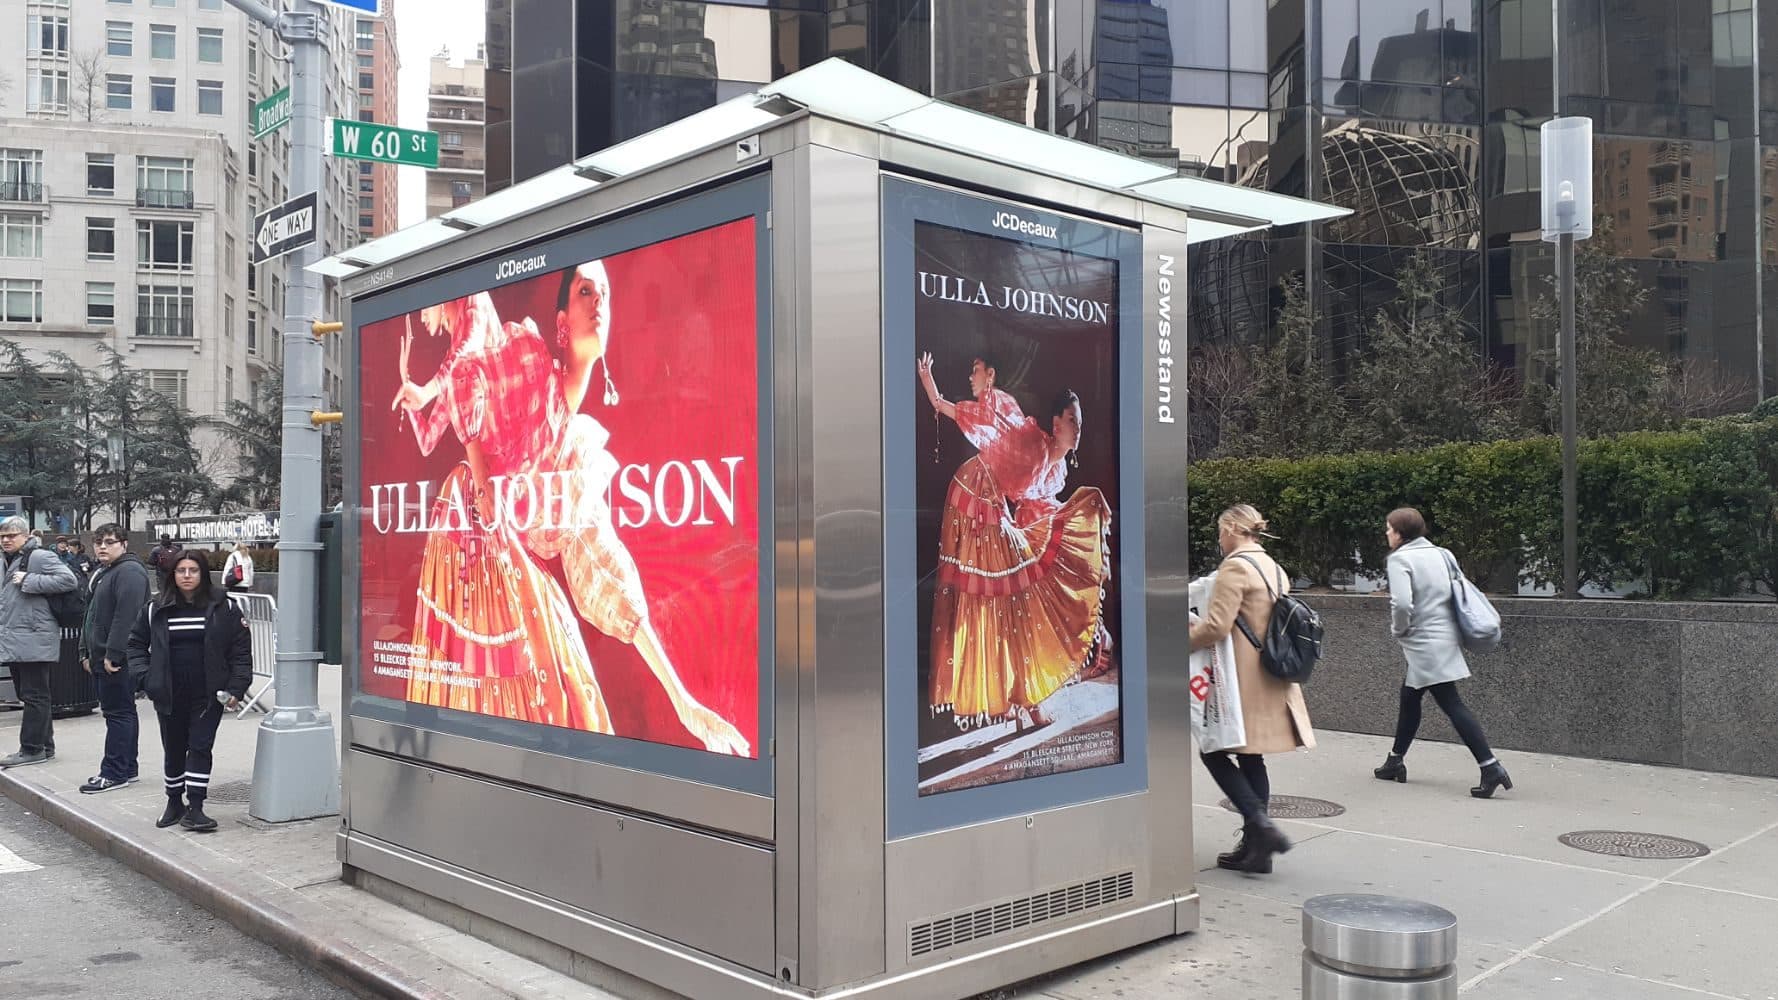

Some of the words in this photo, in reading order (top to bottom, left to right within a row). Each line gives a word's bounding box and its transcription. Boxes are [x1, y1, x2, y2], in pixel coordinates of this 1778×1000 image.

[258, 98, 289, 132] Broadwa
[342, 125, 360, 154] W
[372, 131, 400, 159] 60
[412, 134, 426, 153] St
[262, 223, 279, 246] ONE
[287, 210, 308, 236] WAY
[992, 211, 1057, 240] JCDecaux
[495, 254, 547, 281] JCDecaux
[919, 271, 993, 307] ULLA
[996, 286, 1109, 325] JOHNSON
[1158, 254, 1175, 424] Newsstand
[370, 477, 472, 535] ULLA
[155, 525, 178, 540] TRUMP
[180, 521, 237, 539] INTERNATIONAL
[241, 517, 269, 537] HOTEL
[373, 666, 378, 674] 4
[380, 654, 406, 666] BLEECKER
